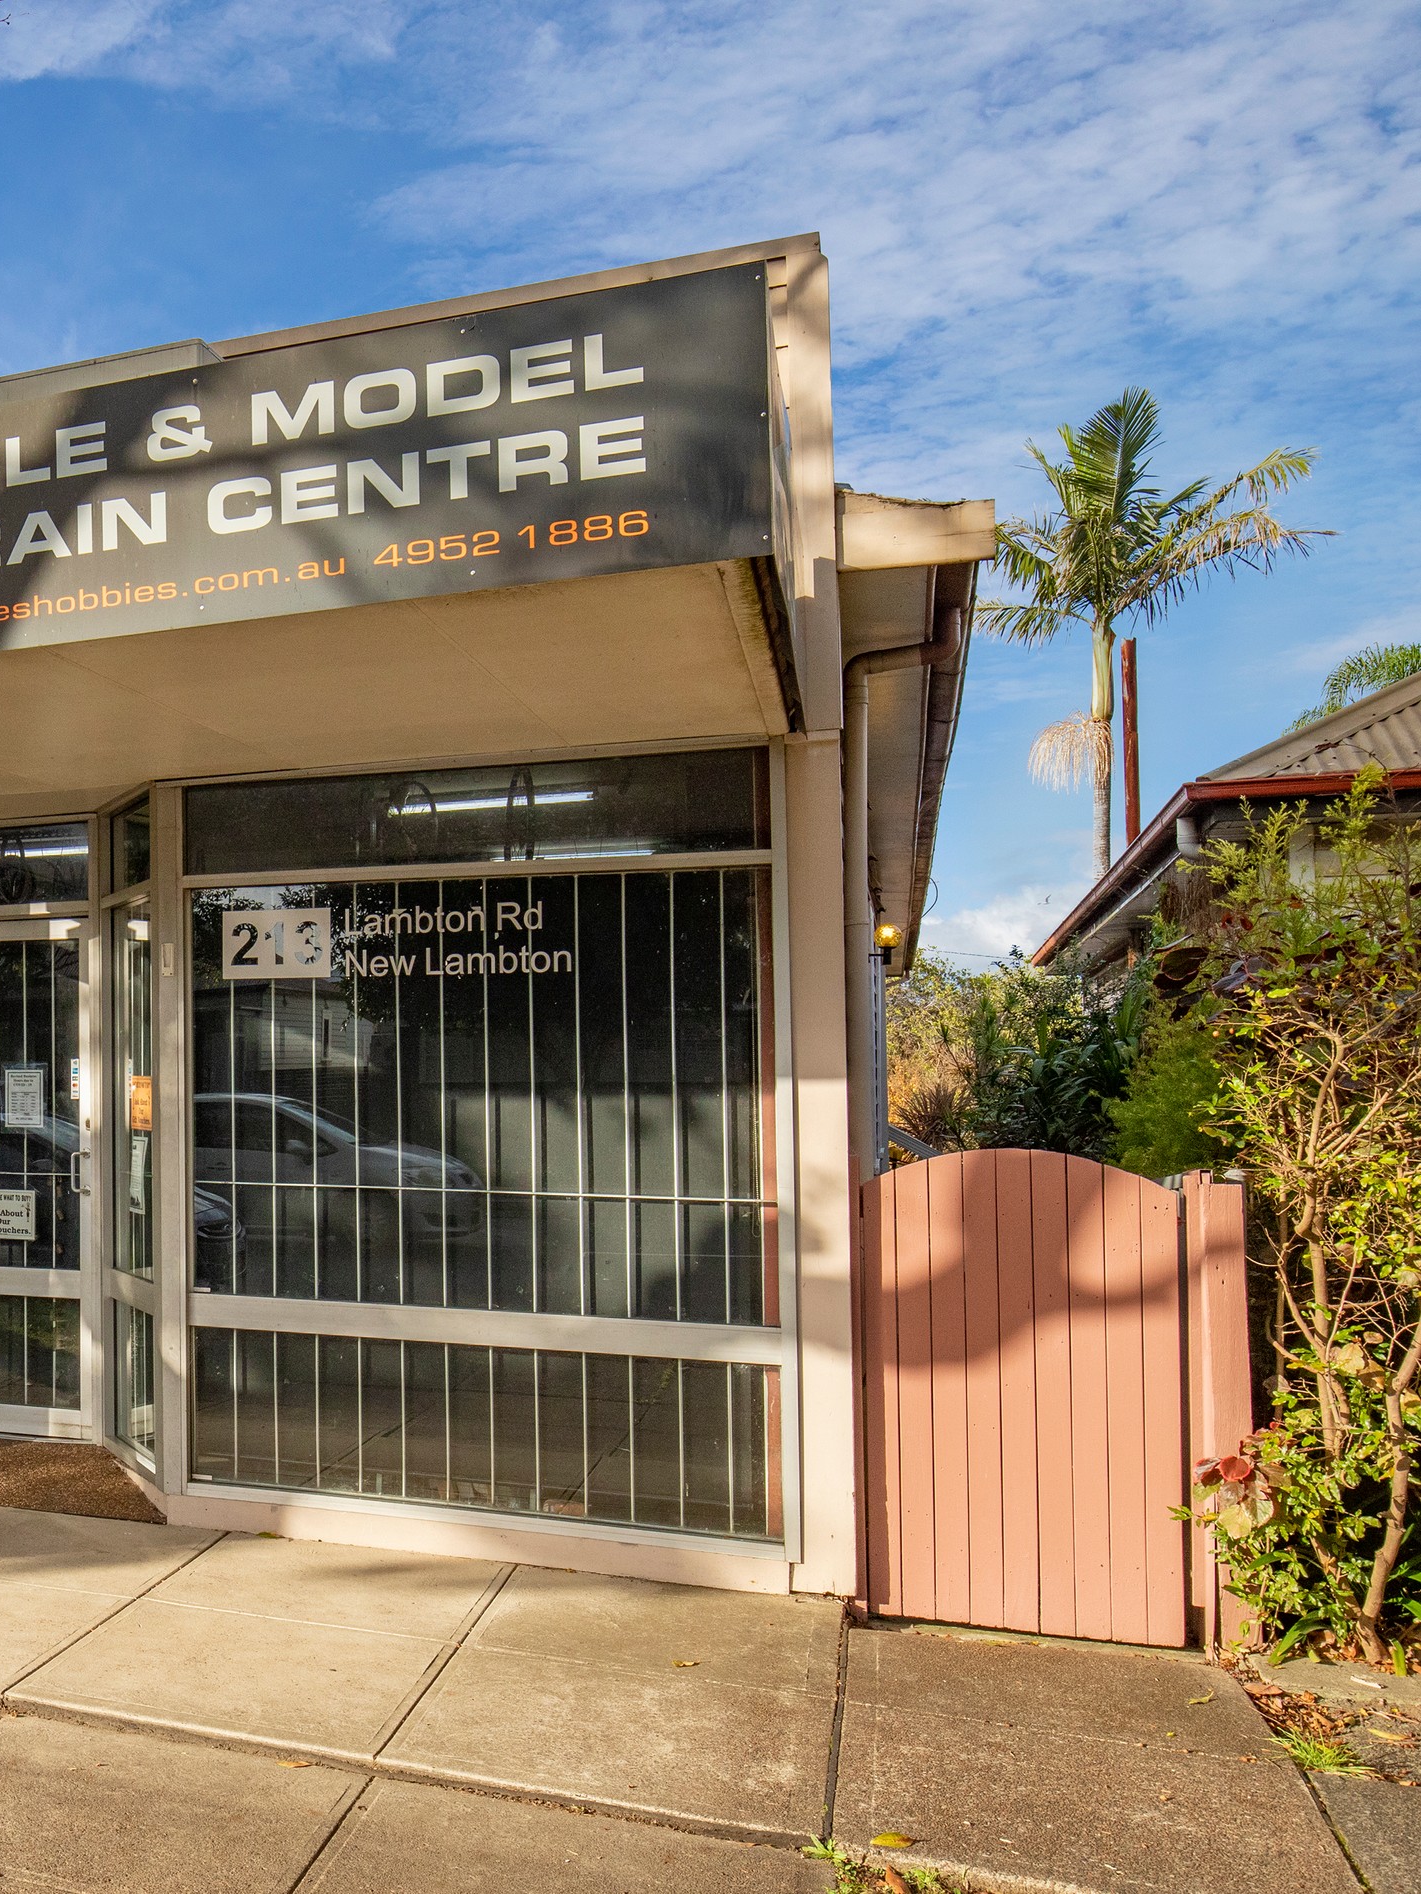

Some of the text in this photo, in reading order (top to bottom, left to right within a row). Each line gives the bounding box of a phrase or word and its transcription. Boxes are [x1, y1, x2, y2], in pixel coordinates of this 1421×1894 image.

[146, 404, 213, 462] &
[251, 333, 645, 446] MODEL
[207, 415, 647, 535] CENTRE
[373, 529, 501, 569] 4952
[517, 510, 650, 550] 1886
[345, 900, 543, 937] Lambton Rd
[230, 919, 323, 966] 213
[345, 946, 573, 978] New Lambton
[0, 1209, 24, 1217] About
